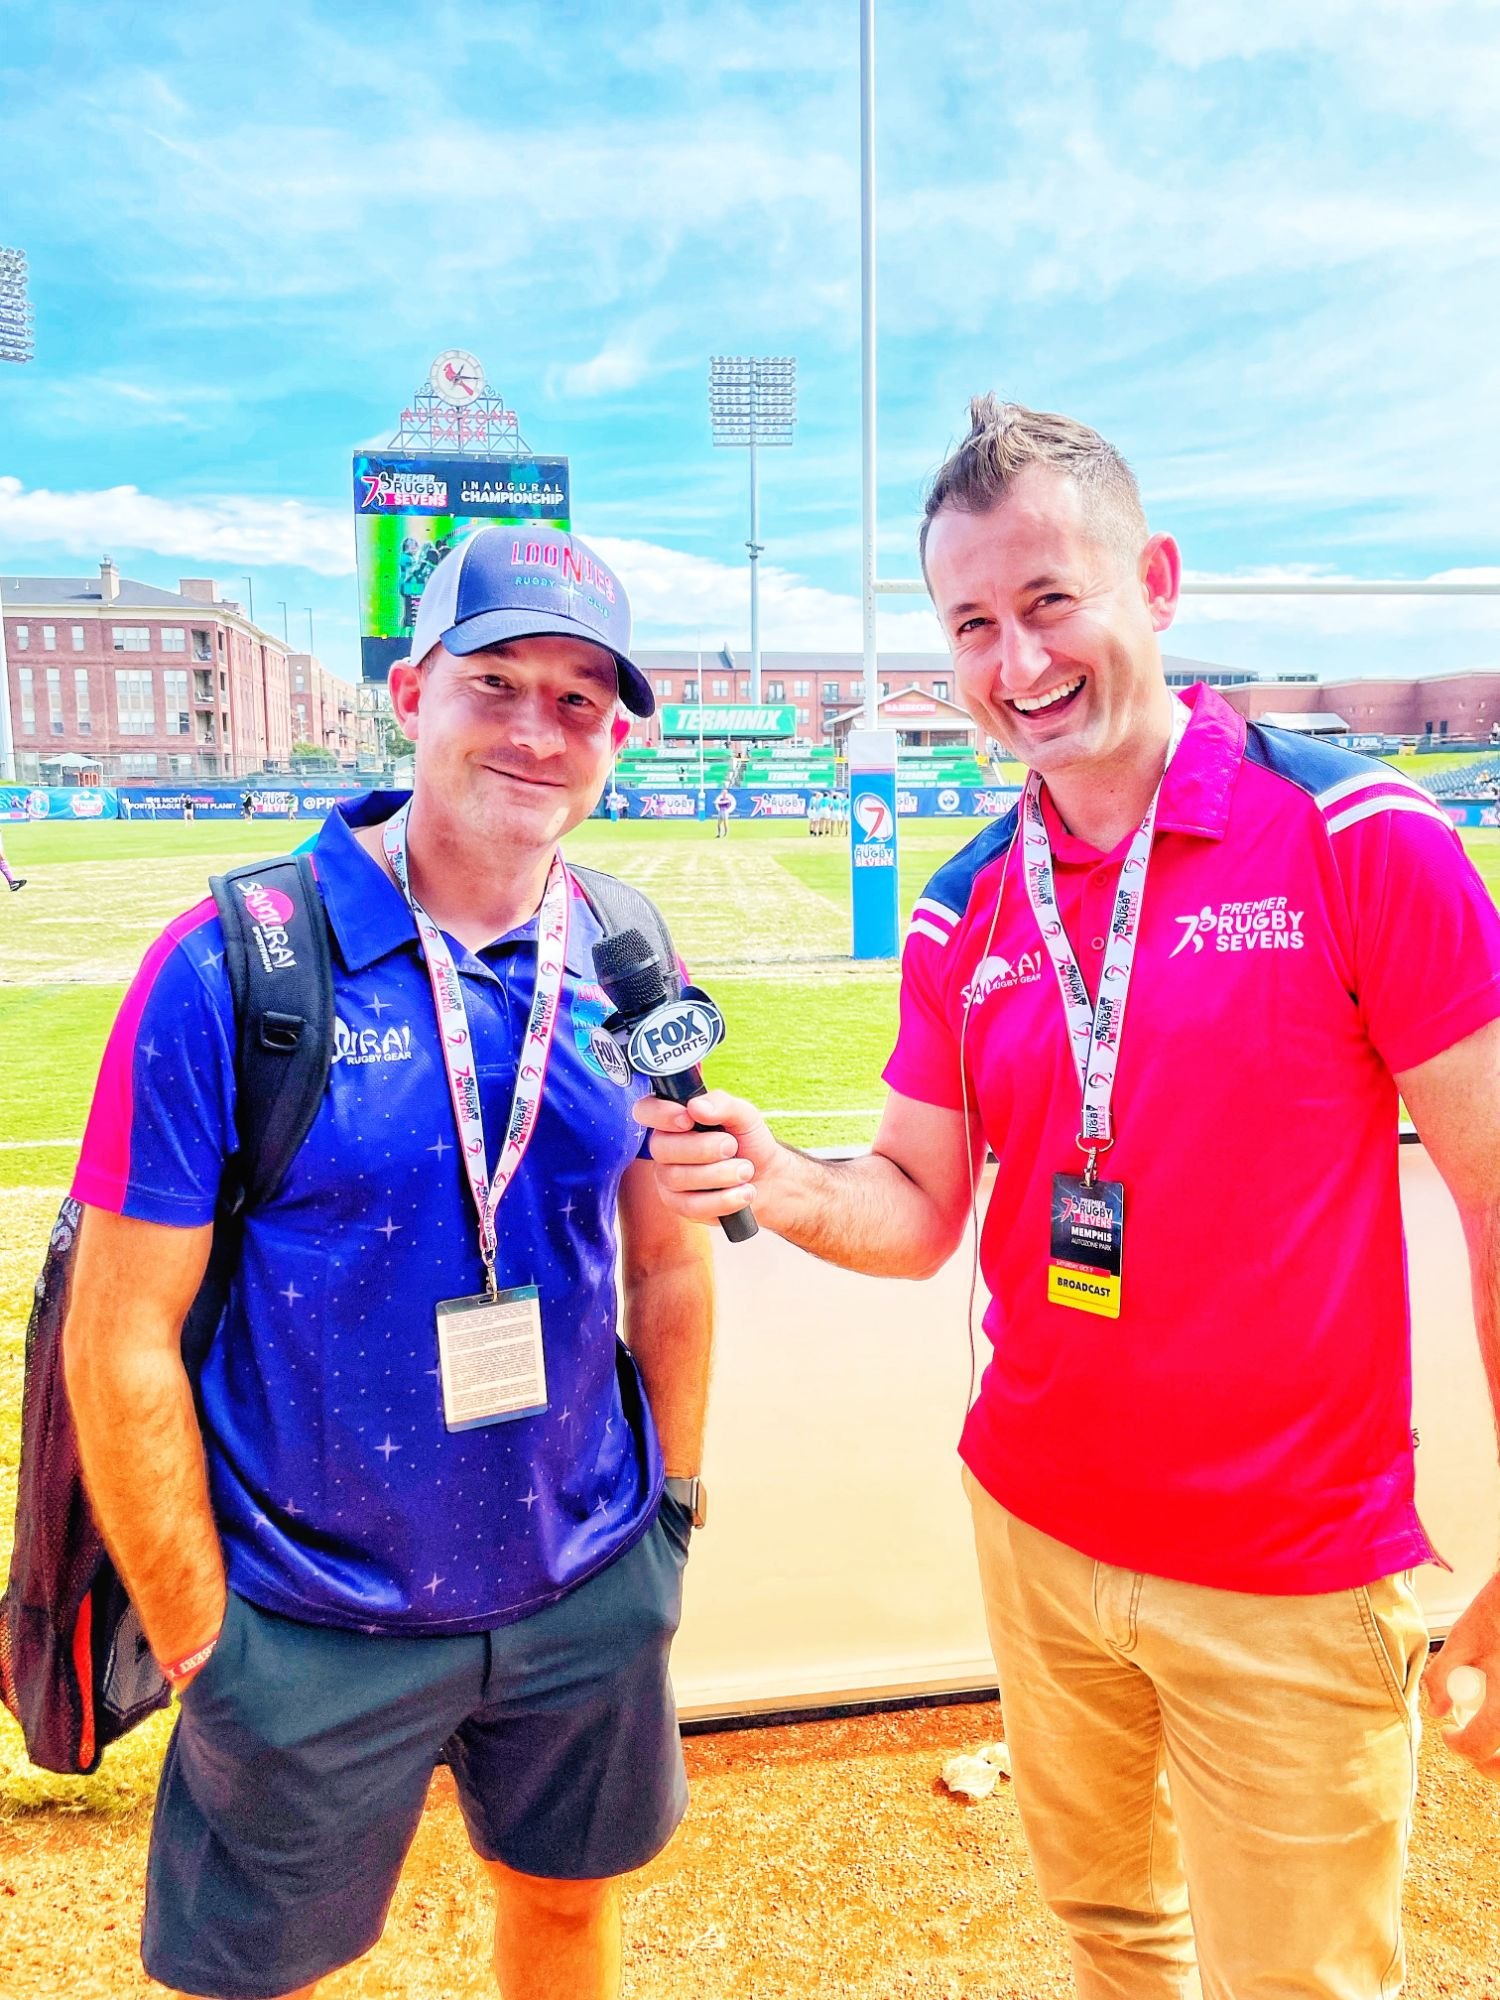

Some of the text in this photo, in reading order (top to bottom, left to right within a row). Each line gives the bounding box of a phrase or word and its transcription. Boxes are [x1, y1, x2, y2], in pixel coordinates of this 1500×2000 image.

[401, 408, 517, 426] AUTOZONE
[432, 425, 488, 441] PARK
[393, 473, 435, 482] PREMIER
[394, 482, 445, 494] RUGBY
[462, 481, 562, 492] INAUGURAL
[394, 494, 447, 506] SEVENS
[461, 491, 564, 505] CHAMPIONSHIP
[511, 541, 616, 604] LOONIES
[515, 576, 609, 617] RUGBY CLUB
[676, 709, 783, 731] TERMINIX
[856, 849, 892, 858] RUGBY
[855, 858, 894, 867] SEVENS
[1220, 896, 1287, 915] PREMIER
[1217, 910, 1304, 934] RUGBY
[1216, 931, 1304, 952] SEVENS
[1020, 974, 1042, 984] GEAR
[1101, 998, 1113, 1033] RUGBY
[643, 1010, 704, 1058] FOX
[347, 1052, 412, 1065] RUGBY GEAR
[594, 1039, 621, 1067] FOX
[653, 1034, 709, 1067] SPORTS
[1080, 1205, 1112, 1217] RUGBY
[1079, 1213, 1112, 1229] SEVENS
[1071, 1226, 1113, 1243] MEMPHIS
[1098, 1243, 1112, 1251] PARK
[1057, 1277, 1111, 1297] BROADCAST
